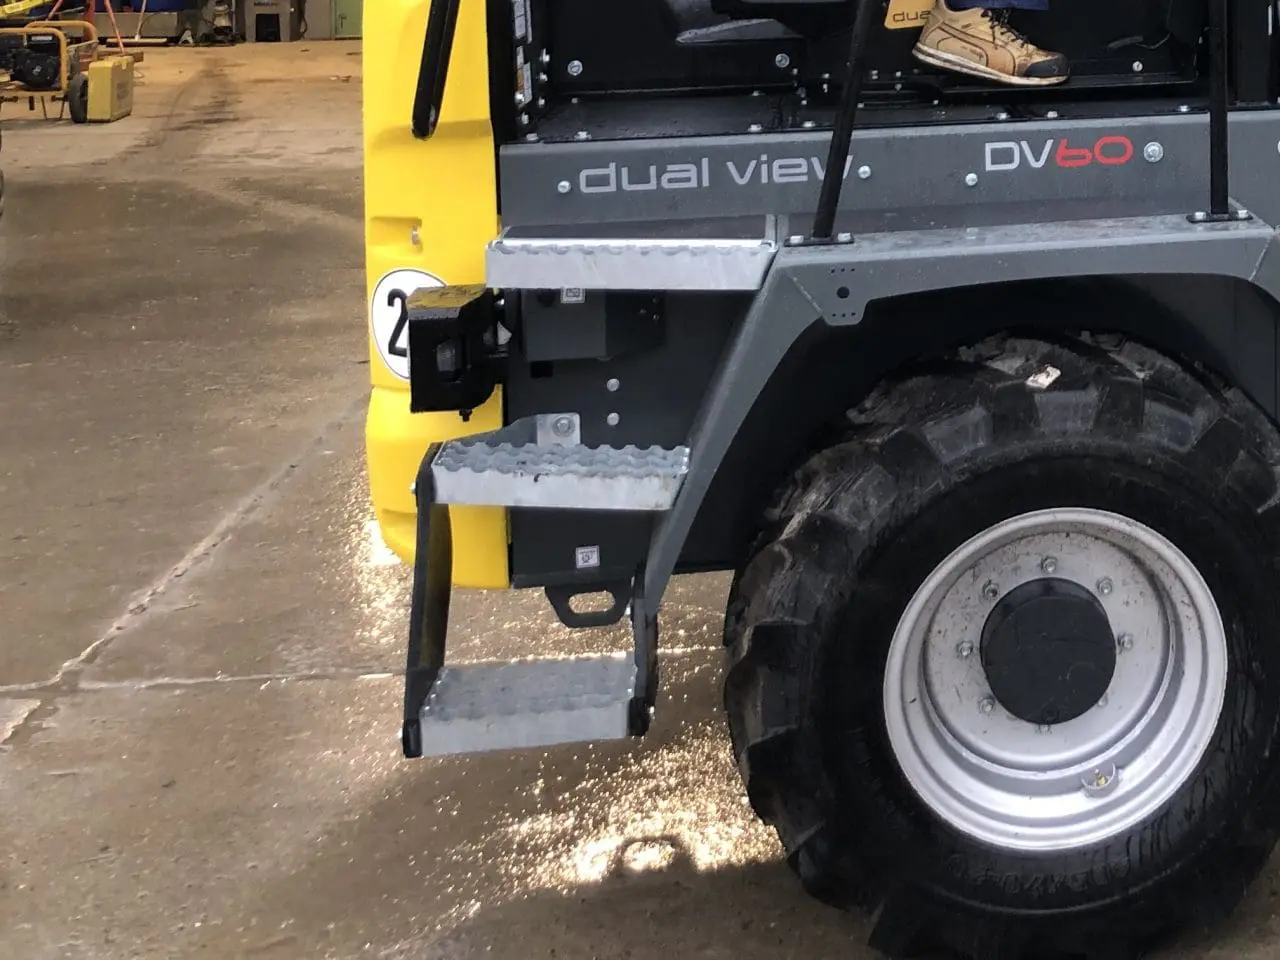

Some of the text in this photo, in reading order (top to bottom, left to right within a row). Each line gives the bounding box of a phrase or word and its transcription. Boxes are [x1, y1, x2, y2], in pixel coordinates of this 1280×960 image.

[893, 10, 931, 23] dua
[985, 136, 1133, 171] DV60
[580, 157, 709, 193] dual
[387, 288, 408, 357] 2
